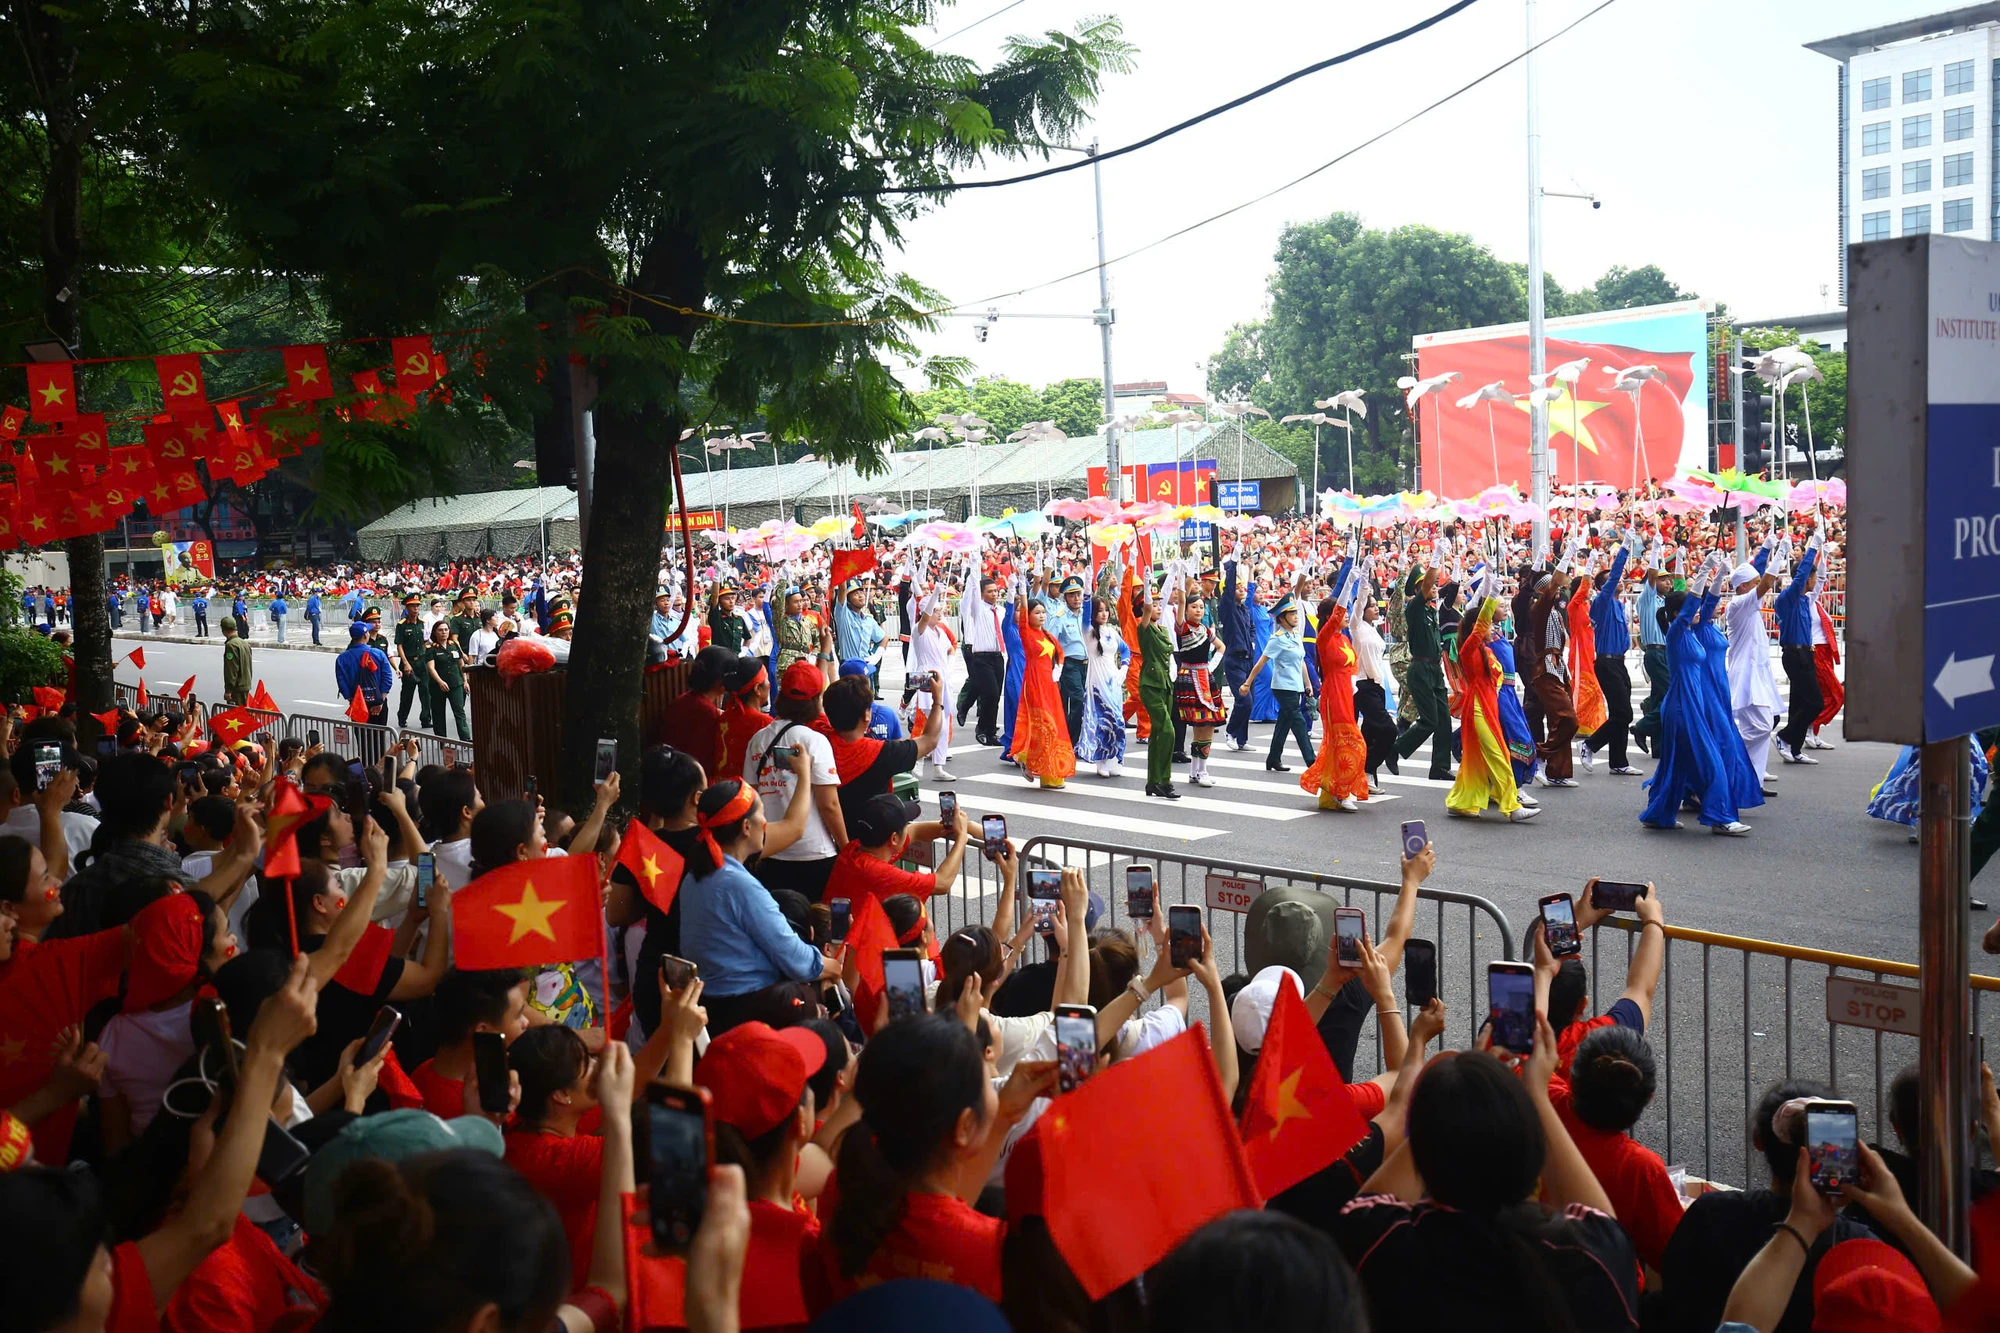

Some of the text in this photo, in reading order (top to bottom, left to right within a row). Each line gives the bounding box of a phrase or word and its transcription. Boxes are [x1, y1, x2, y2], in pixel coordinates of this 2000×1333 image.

[1936, 317, 1997, 340] INSTITUTE
[696, 514, 714, 525] DÂN
[1222, 880, 1246, 890] POLICE
[1218, 891, 1251, 907] STOP
[1854, 985, 1898, 1001] POLICE
[1847, 1000, 1906, 1024] STOP
